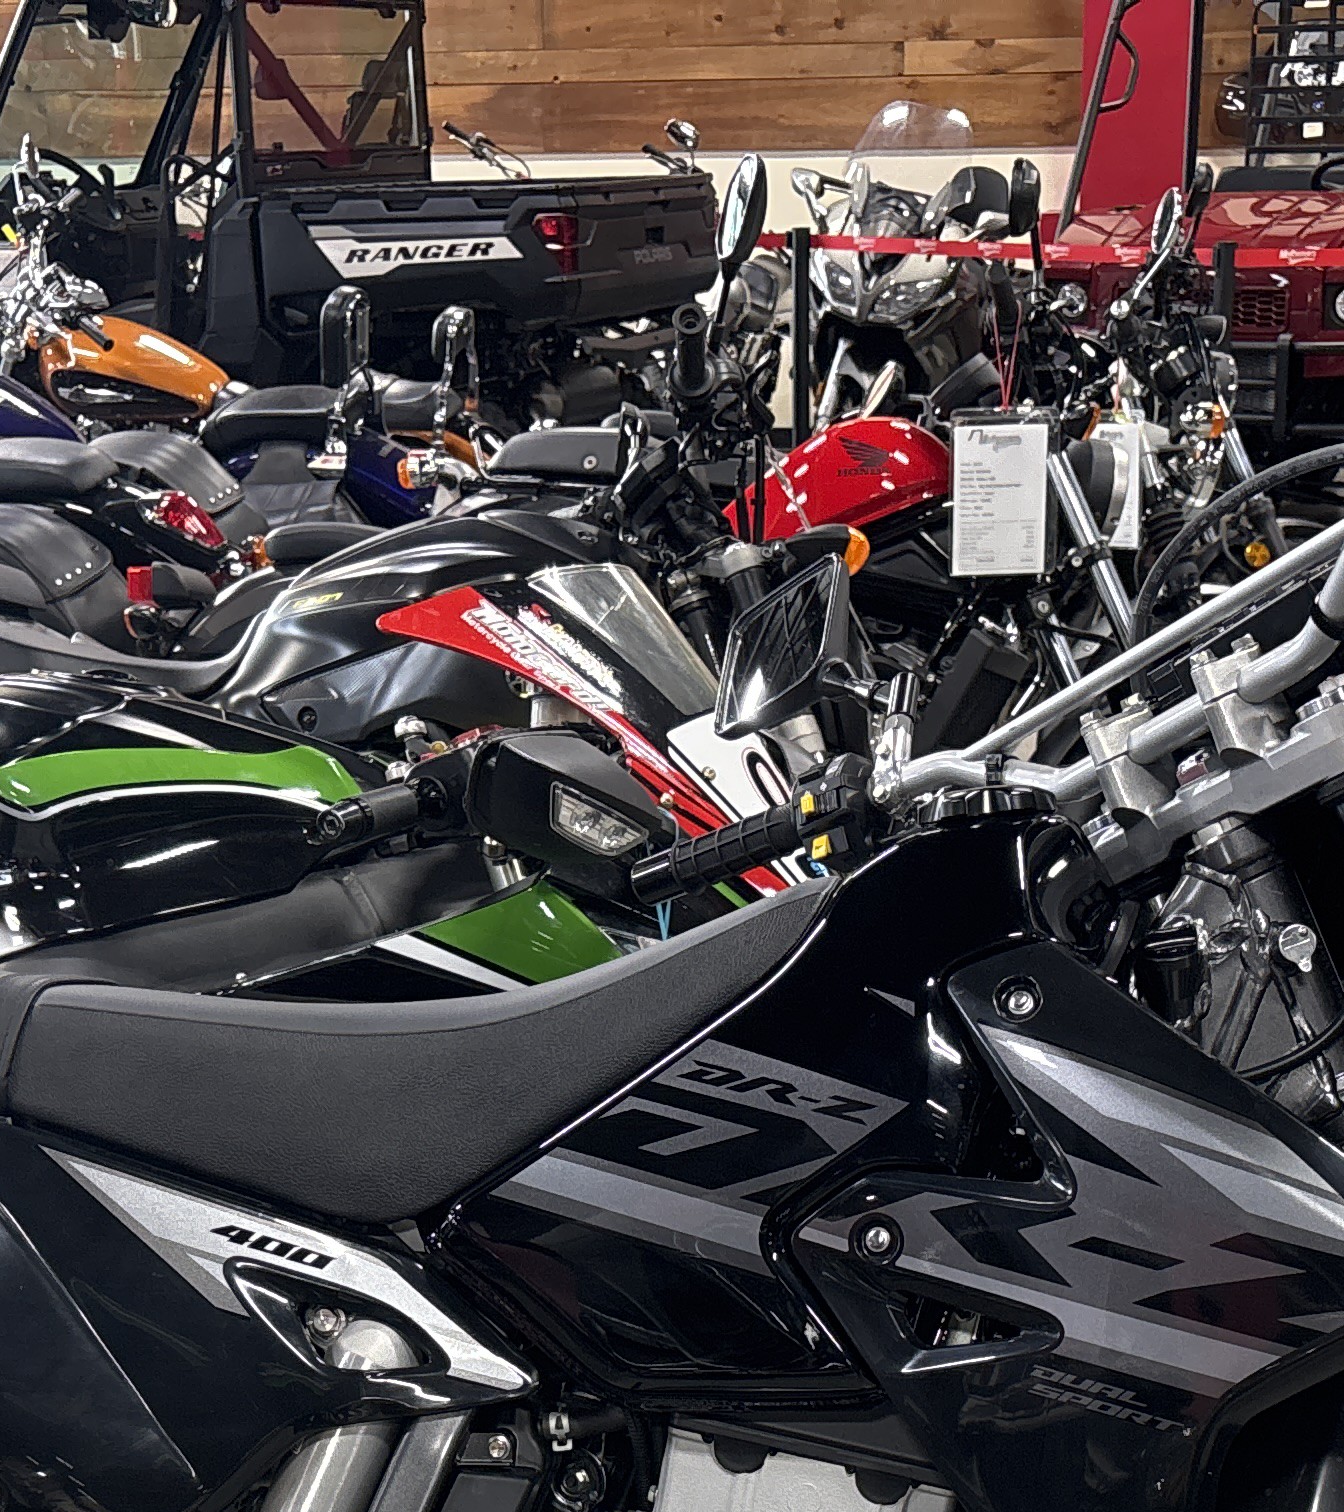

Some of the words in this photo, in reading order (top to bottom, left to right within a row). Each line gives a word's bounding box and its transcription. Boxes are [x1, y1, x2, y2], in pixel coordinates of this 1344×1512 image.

[344, 242, 496, 264] RANGER
[676, 1059, 879, 1127] DR-Z
[209, 1224, 338, 1270] 400
[1028, 1383, 1185, 1431] SPORT
[1030, 1364, 1148, 1408] DUAL
